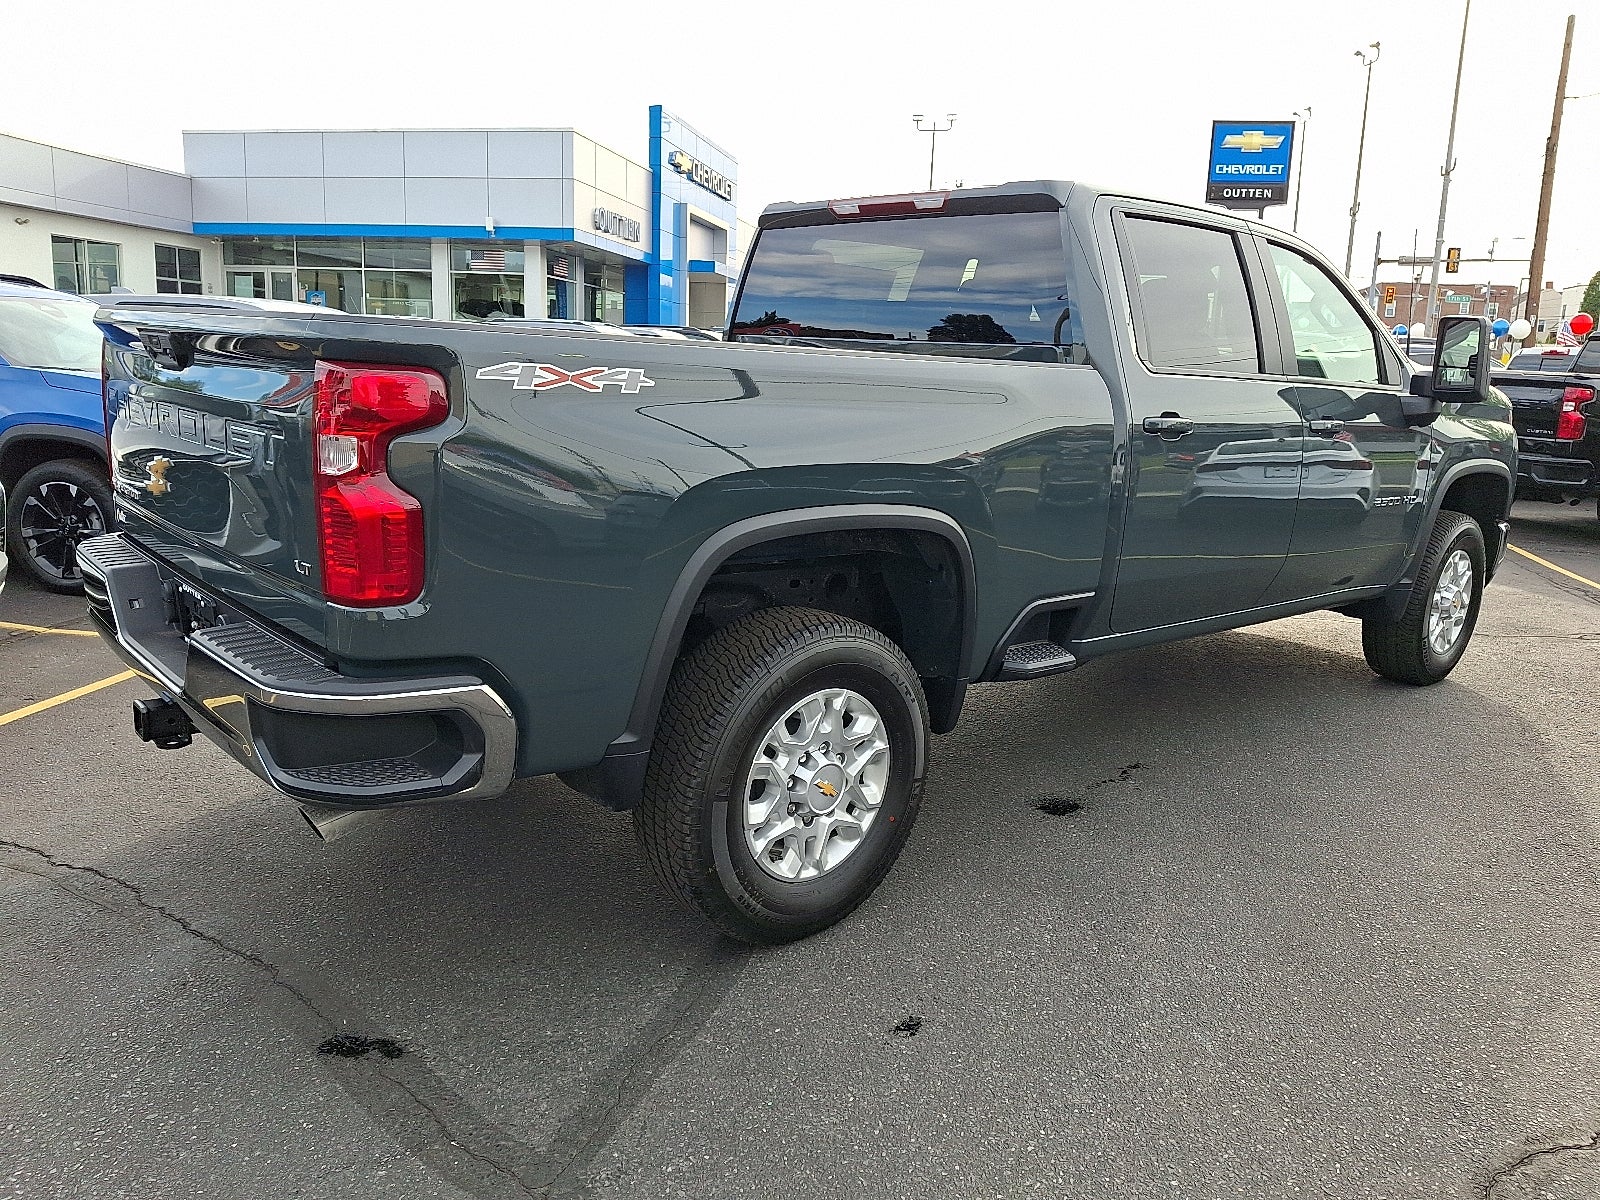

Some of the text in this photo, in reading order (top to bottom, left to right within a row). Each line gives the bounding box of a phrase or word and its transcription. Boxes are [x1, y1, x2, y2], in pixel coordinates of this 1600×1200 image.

[692, 160, 732, 201] CHEVROLET
[1215, 164, 1285, 175] CHEVROLET
[1223, 188, 1272, 198] OUTTEN
[594, 206, 641, 242] OUTTEN
[107, 386, 286, 469] CHEVROLET
[294, 559, 312, 576] LT
